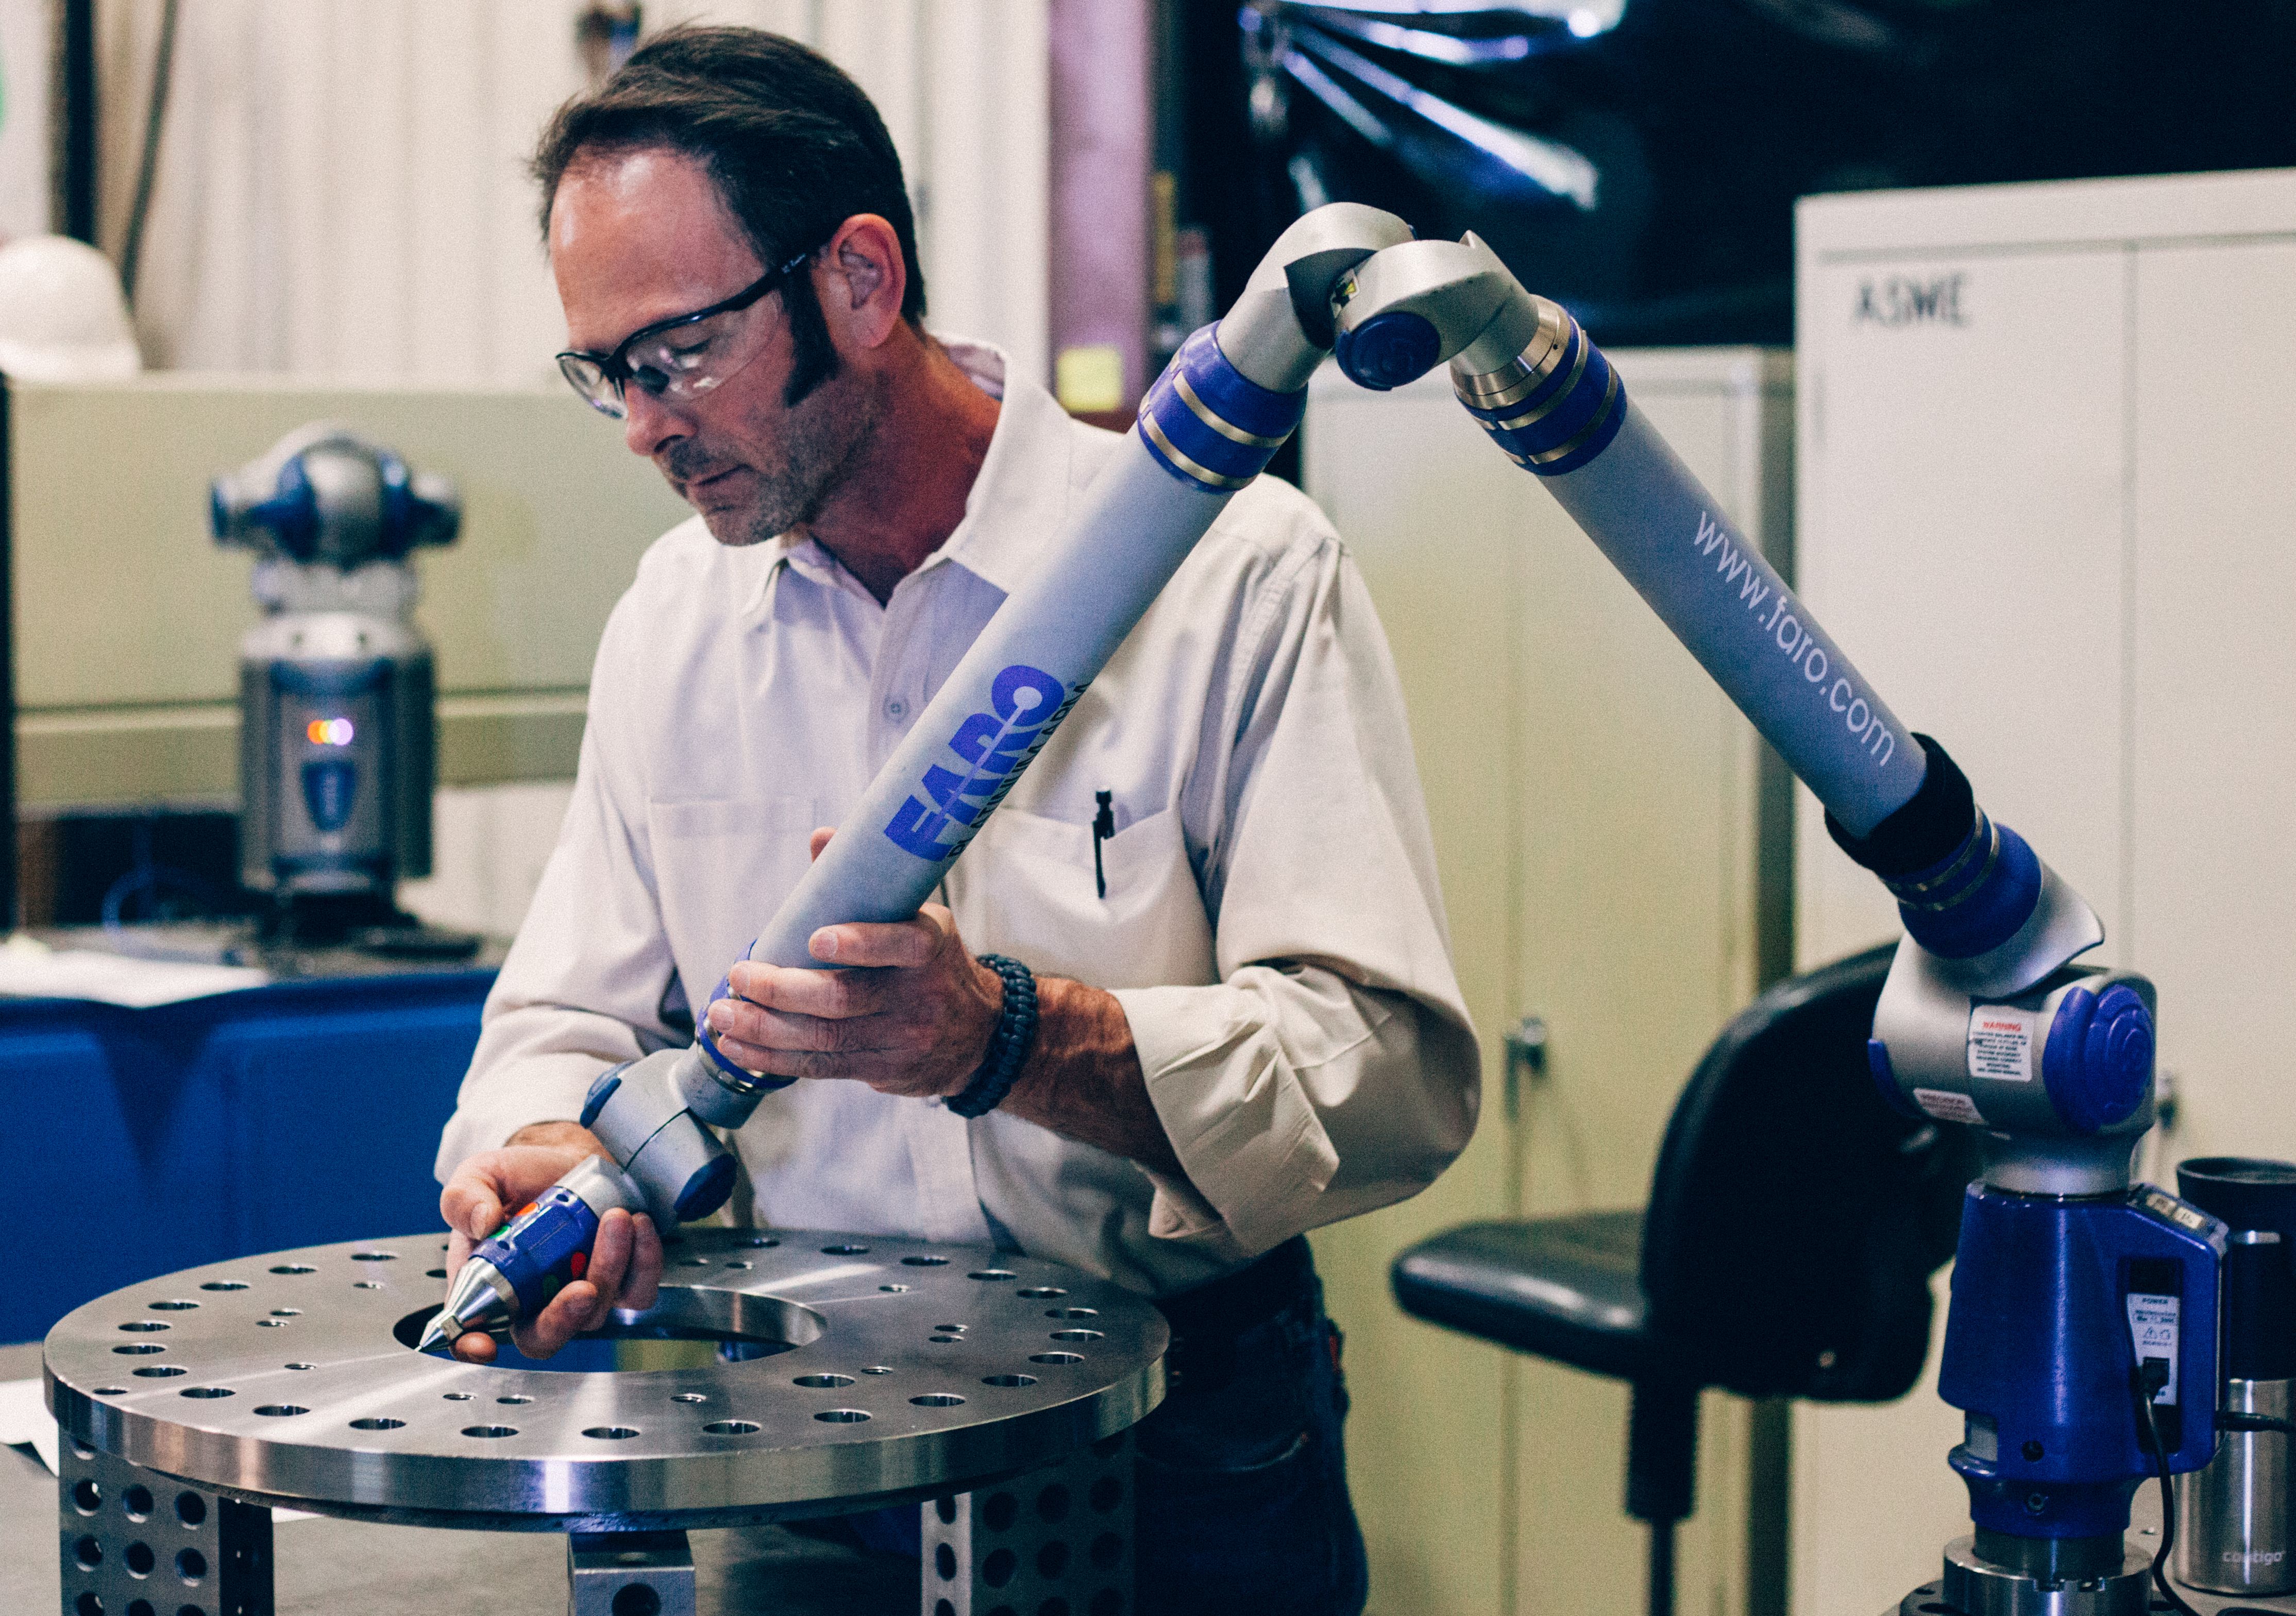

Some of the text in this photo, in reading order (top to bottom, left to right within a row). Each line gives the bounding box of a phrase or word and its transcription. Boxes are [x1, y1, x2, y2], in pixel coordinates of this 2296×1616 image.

[1694, 511, 1895, 767] www.faro.com
[883, 665, 1065, 862] FARO
[2223, 1550, 2286, 1566] cotigo
